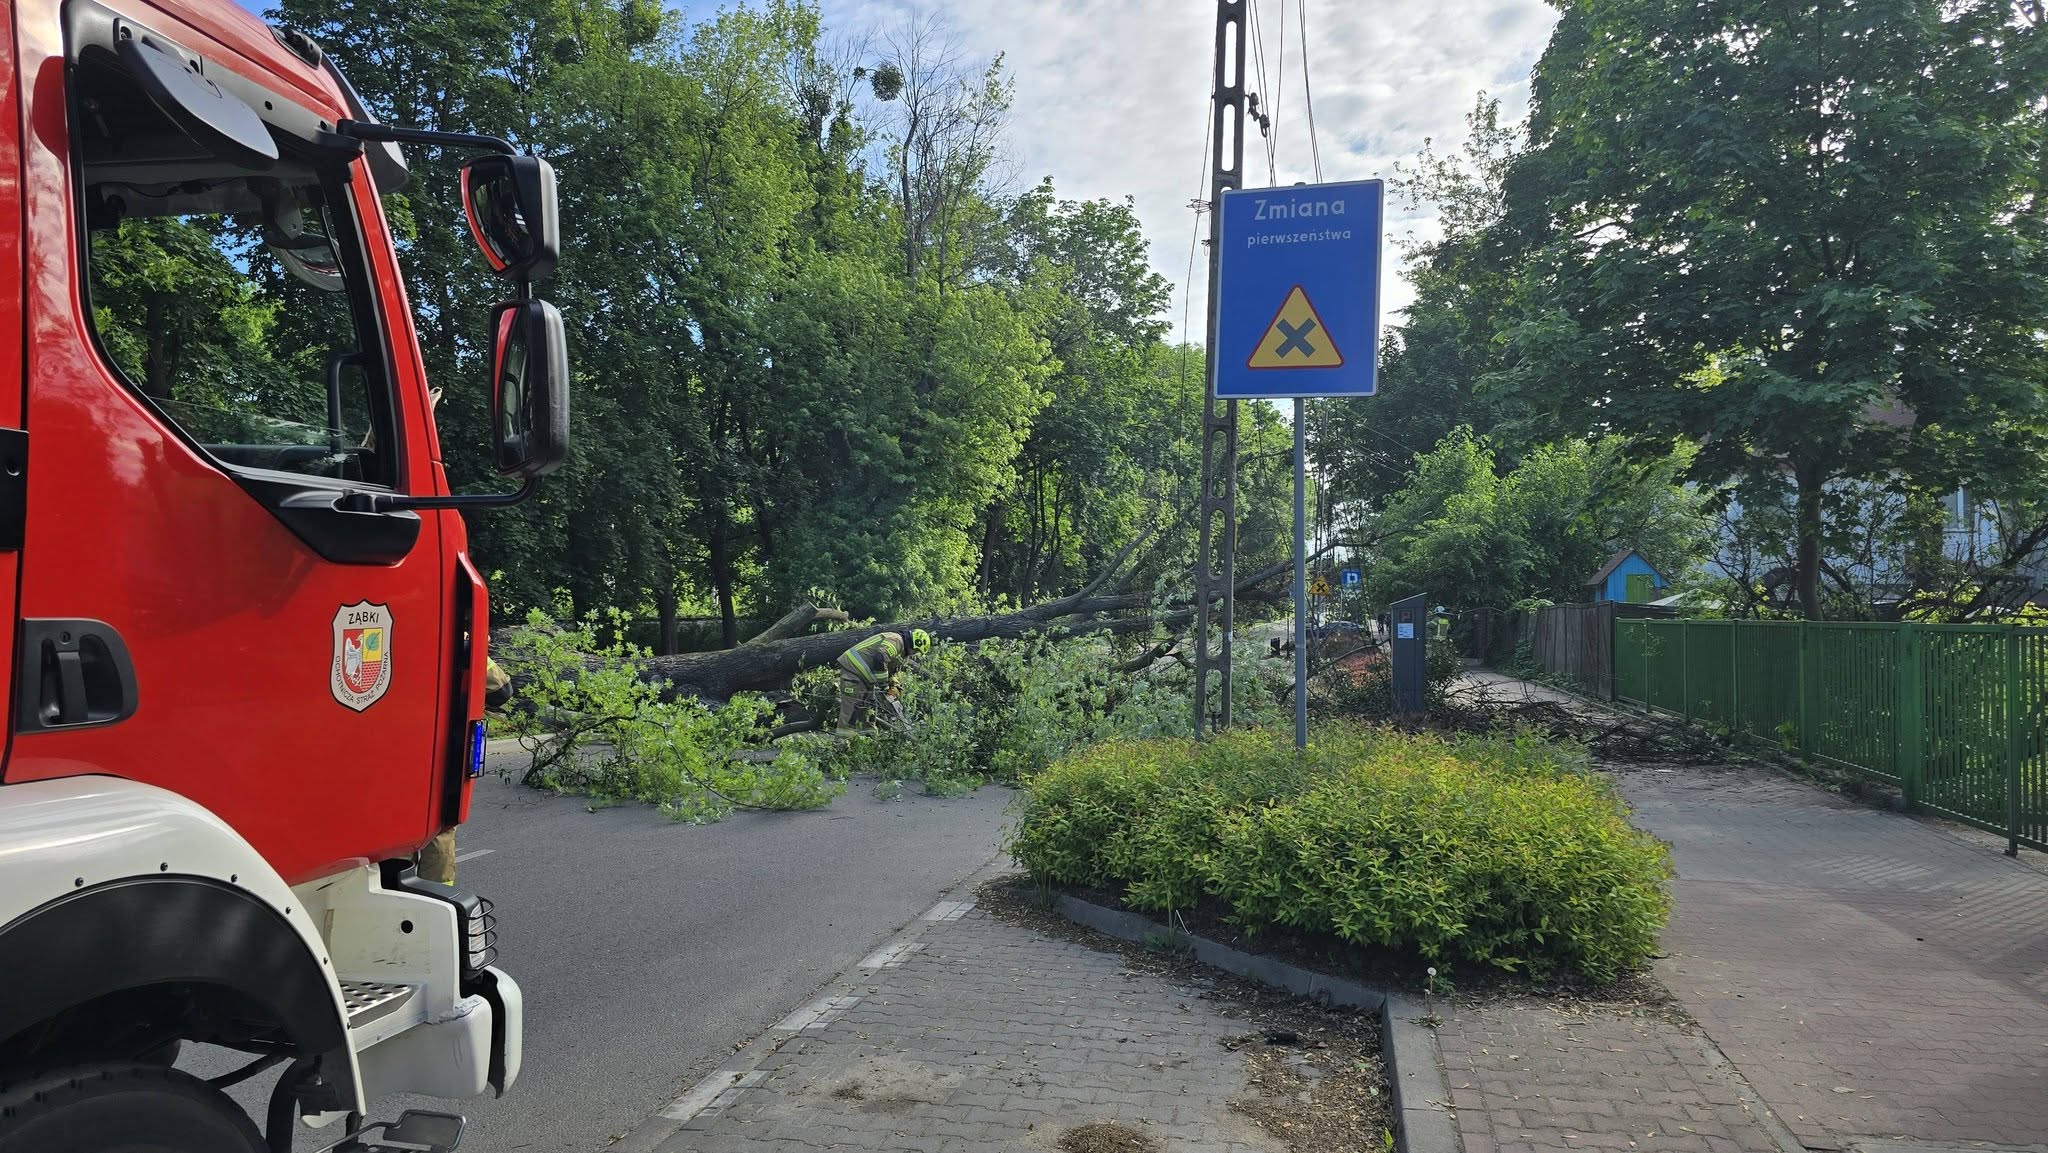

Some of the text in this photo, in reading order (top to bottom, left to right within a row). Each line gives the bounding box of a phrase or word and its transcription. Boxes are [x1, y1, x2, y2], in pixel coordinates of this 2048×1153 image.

[1254, 199, 1345, 221] Zmiana
[1247, 229, 1352, 248] pierwszeństwa
[348, 611, 379, 625] ZĄBKI
[335, 655, 354, 703] OCHOTNICZA
